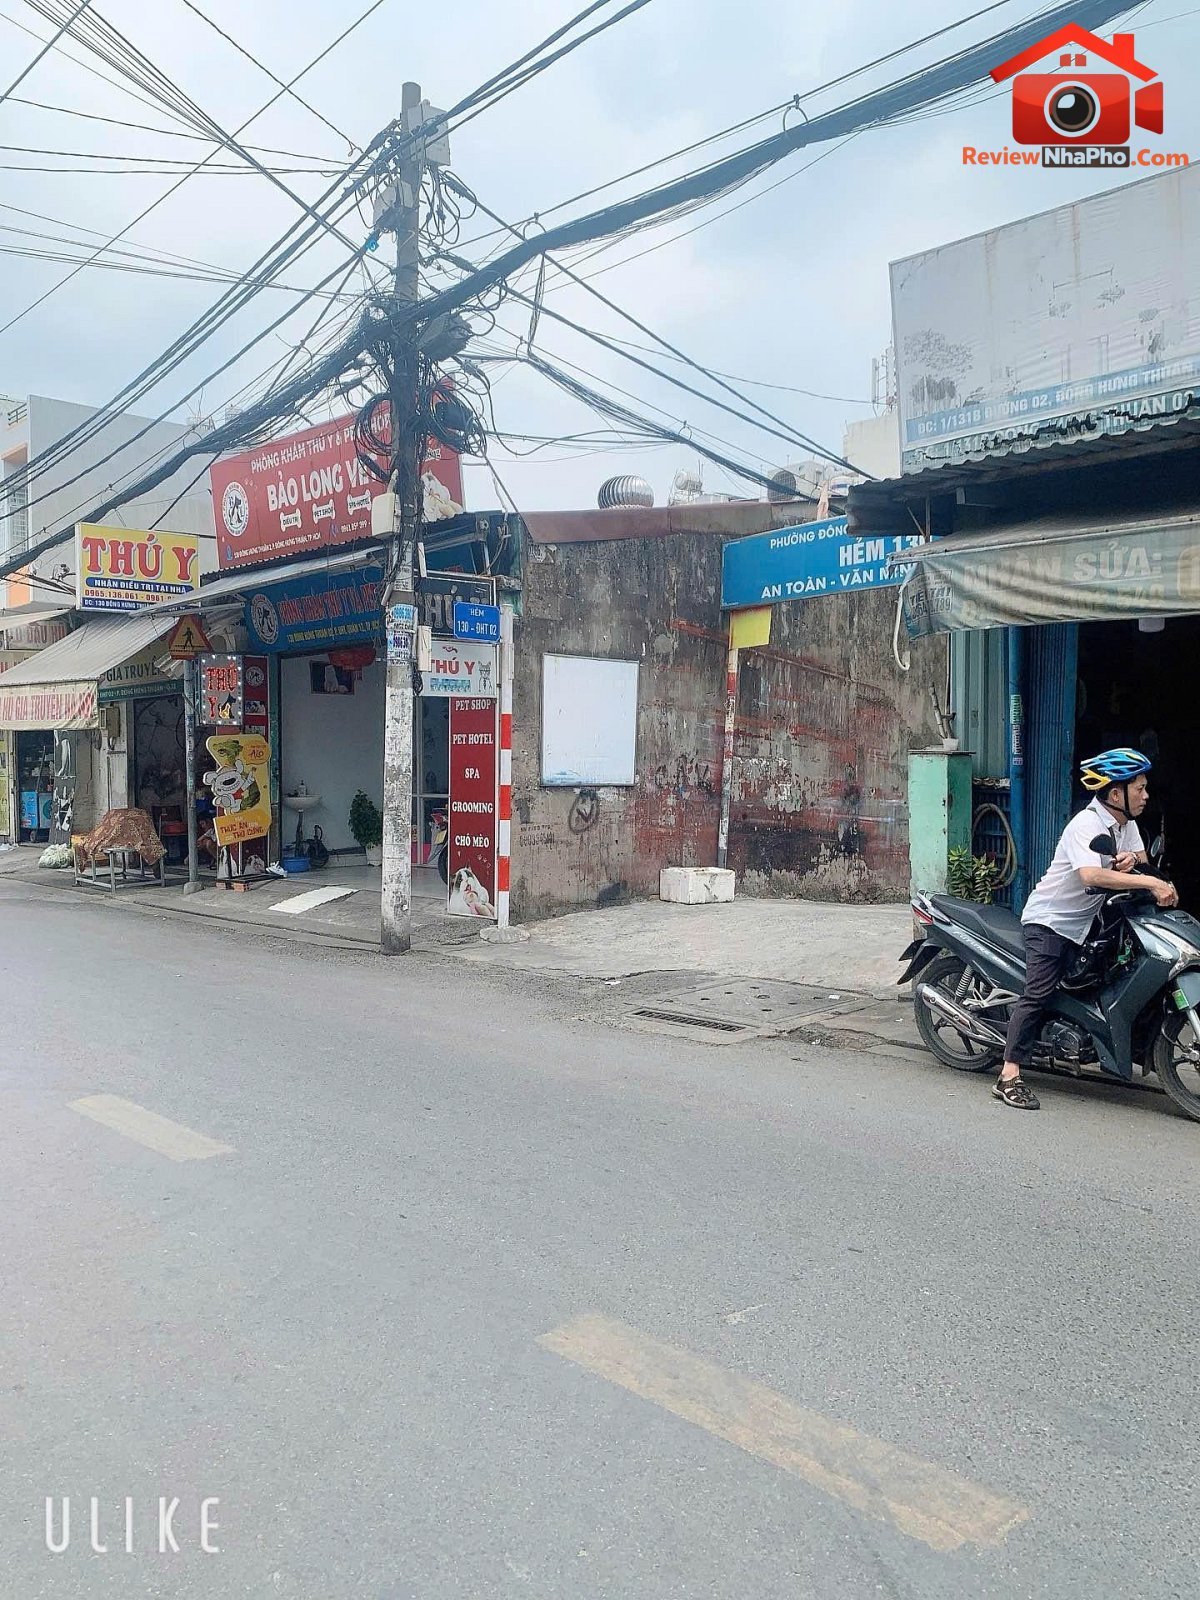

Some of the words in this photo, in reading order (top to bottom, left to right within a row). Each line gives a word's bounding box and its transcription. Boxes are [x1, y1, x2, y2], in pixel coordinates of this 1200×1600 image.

[250, 452, 280, 475] PHÒNG
[280, 441, 306, 465] KHÁM
[306, 433, 326, 456] THÚ
[327, 433, 333, 449] Y
[266, 470, 299, 512] BẢO
[301, 463, 344, 502] LONG
[769, 529, 816, 550] PHƯỜNG
[82, 532, 163, 579] THÚ
[171, 545, 196, 581] Y
[94, 579, 118, 589] NHẬN
[761, 585, 782, 600] AN
[785, 574, 827, 595] TOÀN
[839, 567, 874, 588] VĂN
[457, 620, 469, 633] 130
[489, 624, 497, 636] 02
[106, 667, 122, 682] GIA
[464, 660, 476, 675] Y
[207, 696, 217, 719] Y
[455, 700, 469, 711] PET
[470, 699, 491, 710] SHOP
[452, 734, 467, 745] PET
[468, 733, 493, 745] HOTEL
[464, 767, 480, 779] SPA
[451, 801, 493, 814] GROOMING
[455, 833, 471, 847] CHÓ
